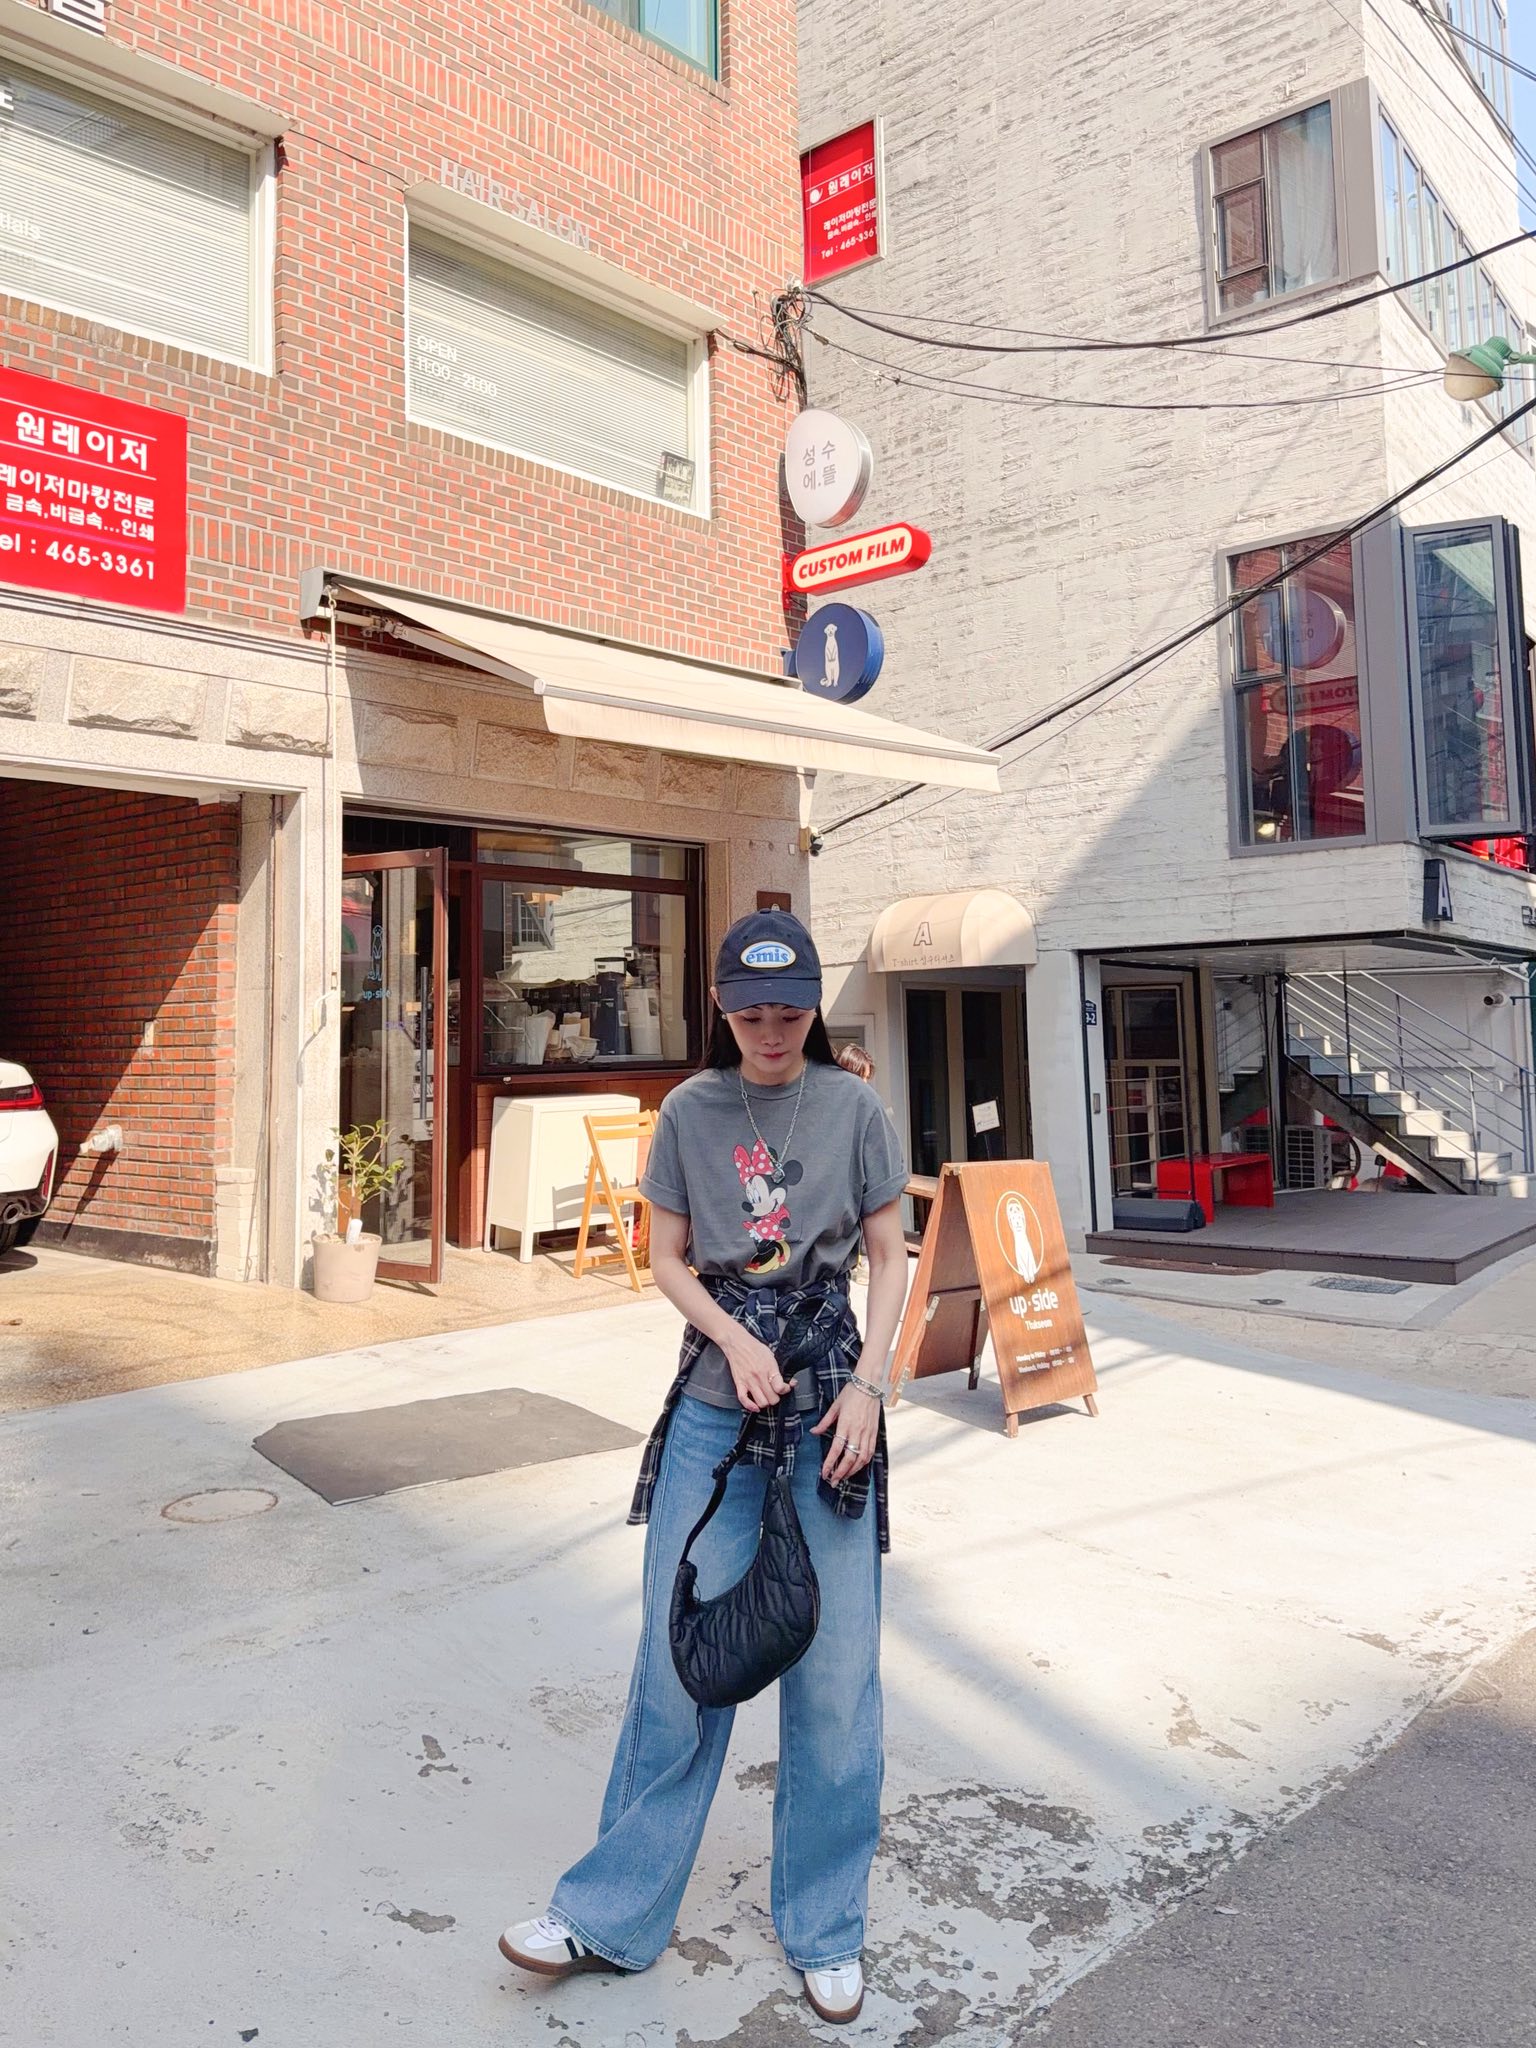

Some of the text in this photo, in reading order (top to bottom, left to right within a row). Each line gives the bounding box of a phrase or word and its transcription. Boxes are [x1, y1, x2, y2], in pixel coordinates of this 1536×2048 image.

[827, 162, 874, 195] 원레이저
[440, 157, 590, 250] HAIR SALON
[821, 247, 834, 259] Tel
[417, 335, 457, 361] OPEN
[16, 411, 148, 471] 원레이저
[0, 462, 154, 520] 레이저마킹전문
[45, 541, 154, 581] 465-3361
[798, 536, 906, 580] CUSTOM FILM
[913, 921, 933, 947] A
[745, 948, 790, 964] emis
